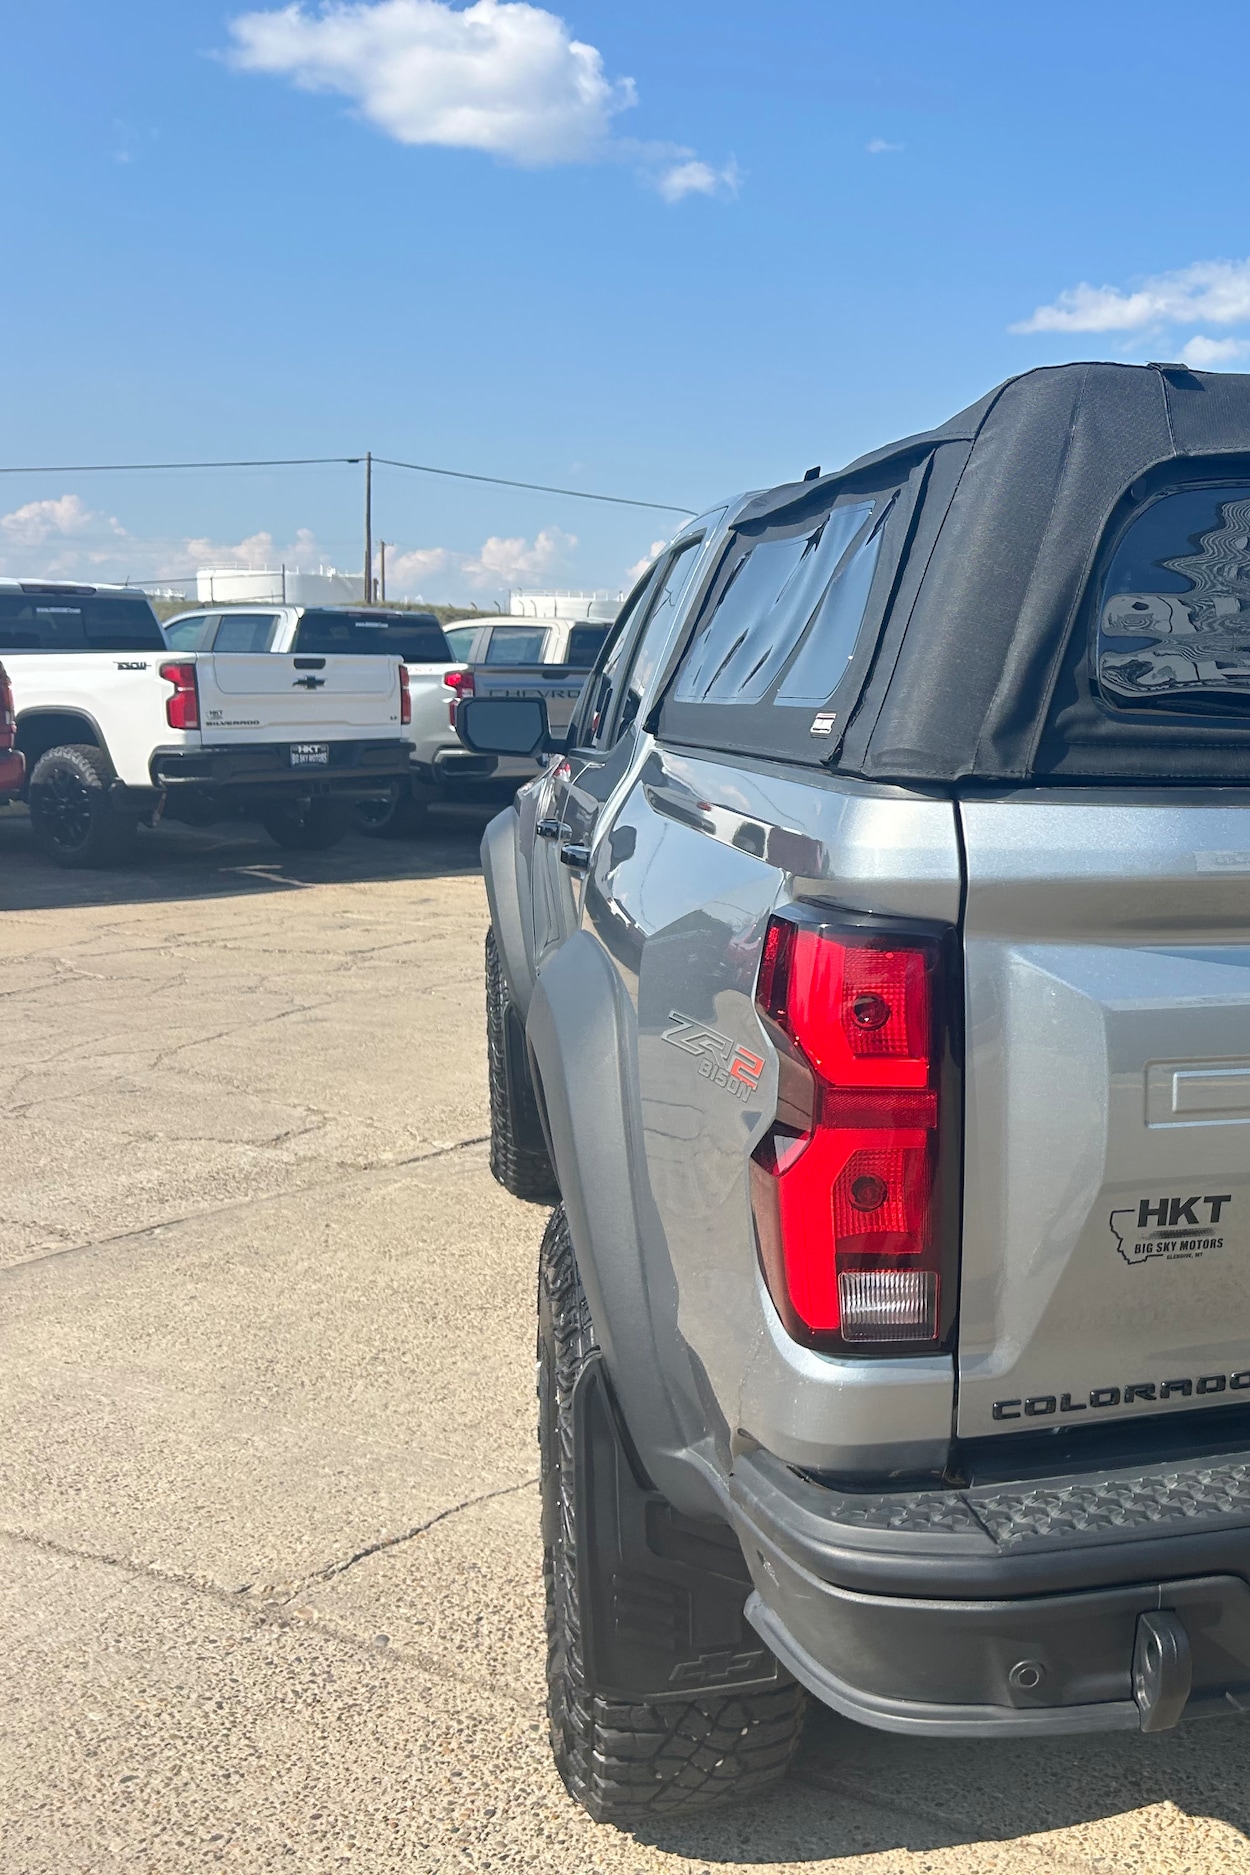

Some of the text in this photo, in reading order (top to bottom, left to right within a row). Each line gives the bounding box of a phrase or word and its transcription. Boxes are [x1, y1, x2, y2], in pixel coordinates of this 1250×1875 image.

[206, 719, 260, 727] SILVERADO
[298, 744, 320, 753] HKT
[661, 1009, 765, 1091] ZR2
[697, 1057, 752, 1103] BISON
[1137, 1195, 1232, 1228] HKT
[1134, 1238, 1224, 1254] BIG SKY MOTORS
